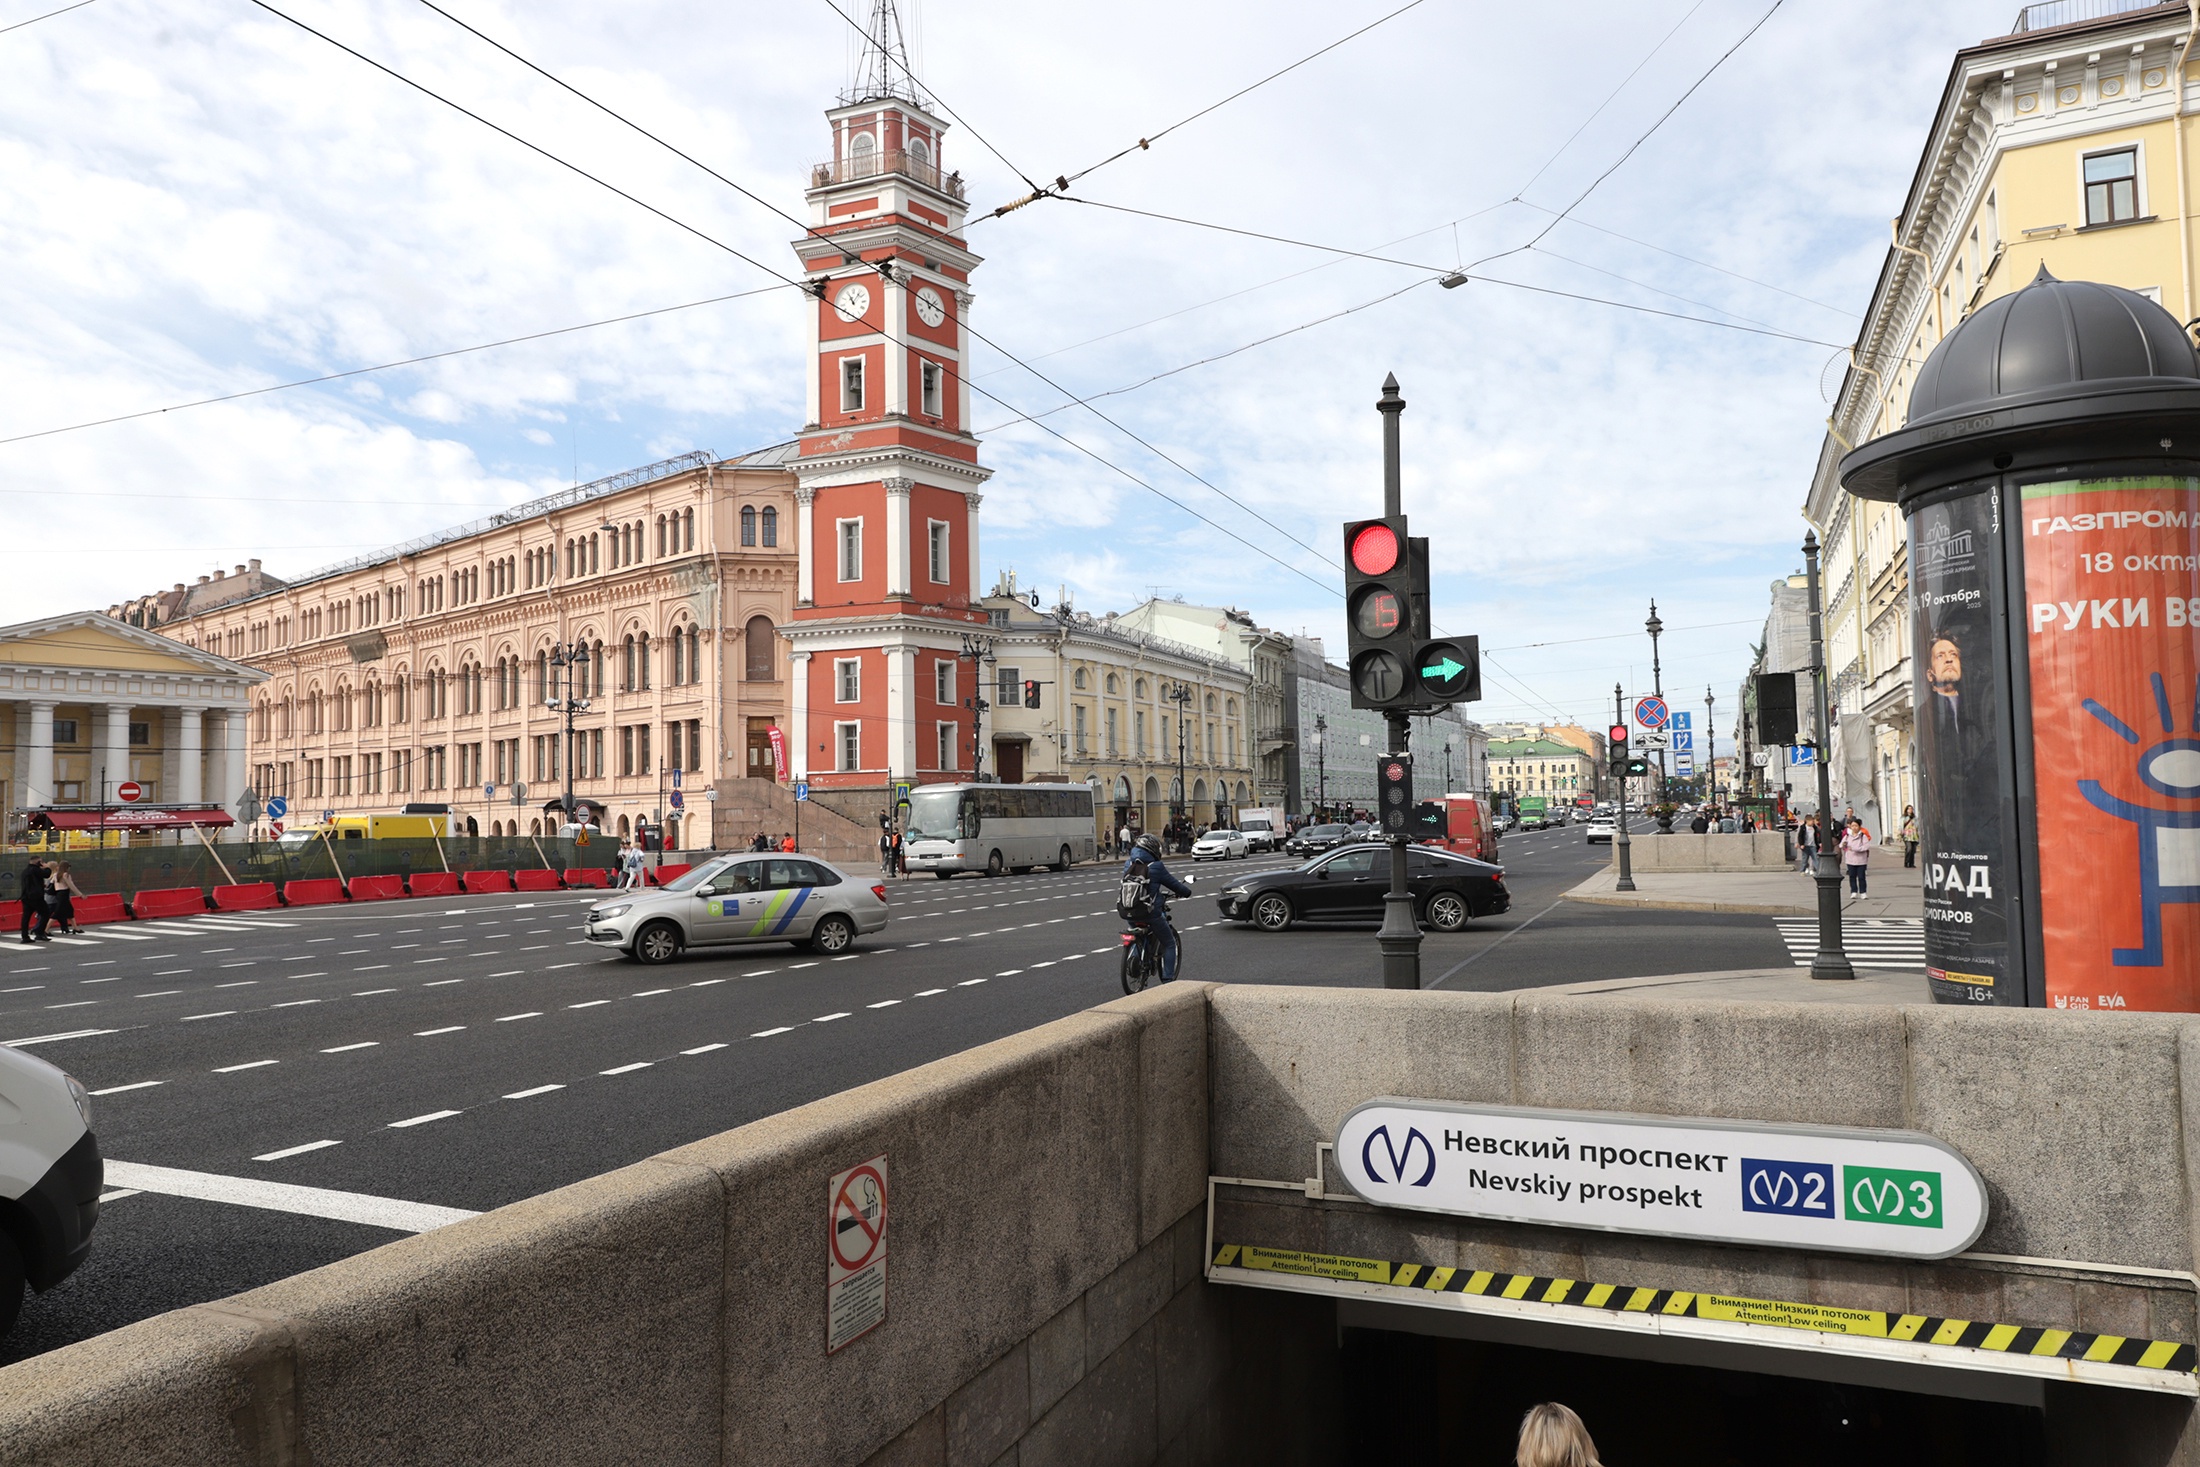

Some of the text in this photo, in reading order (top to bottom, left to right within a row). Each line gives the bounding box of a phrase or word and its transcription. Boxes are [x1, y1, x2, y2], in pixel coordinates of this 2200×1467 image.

[1990, 486, 1999, 534] 10117
[2032, 510, 2187, 537] ГАЗПРОМ
[2080, 552, 2200, 574] 18 октя
[1921, 591, 1931, 609] 19
[1933, 589, 1980, 603] октября
[1966, 602, 1982, 610] 2025
[1375, 594, 1398, 627] 15
[2032, 597, 2149, 633] РУКИ
[1950, 853, 1989, 861] Лермонтов
[1967, 986, 1994, 1002] 16+
[2098, 991, 2126, 1009] EVA
[1444, 1129, 1729, 1173] Невский проспект
[1469, 1168, 1703, 1209] Nevskiy prospekt
[1252, 1248, 1379, 1270] Внимание! Низкий потолок
[842, 1266, 876, 1290] Запрещается
[1271, 1261, 1359, 1280] Attention! Low ceiling
[1710, 1296, 1871, 1322] Внимание! Низкий потолок
[1735, 1310, 1847, 1332] Attention! Low ceiling
